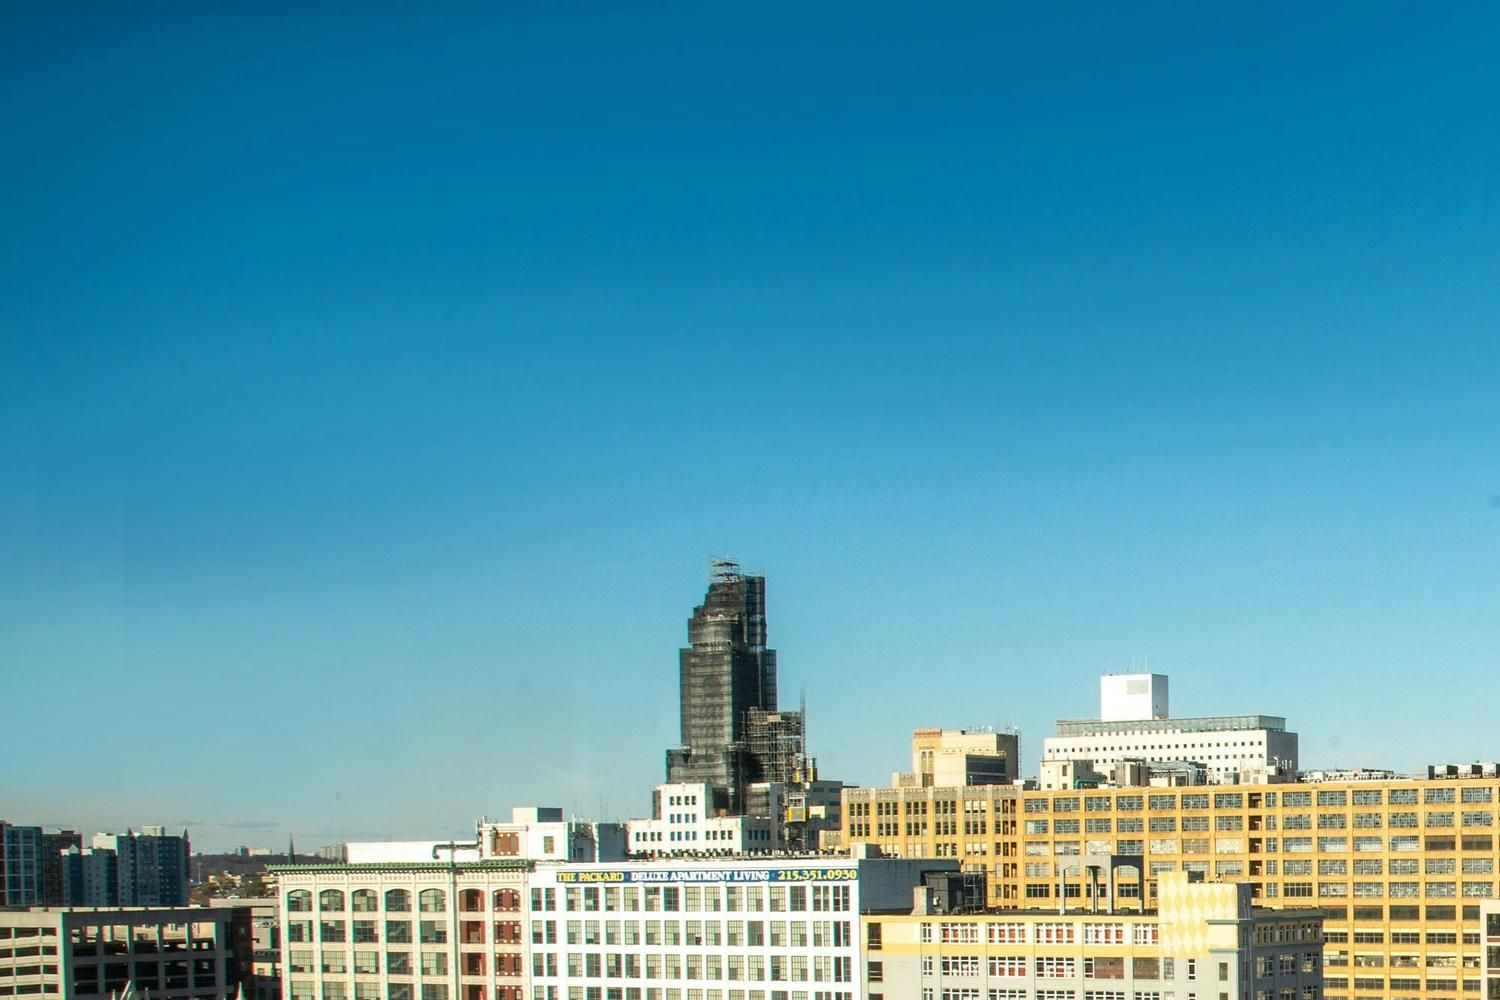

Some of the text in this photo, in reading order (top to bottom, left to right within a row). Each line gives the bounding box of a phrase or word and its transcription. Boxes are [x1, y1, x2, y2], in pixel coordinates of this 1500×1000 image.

[557, 869, 857, 881] THE PACKARD DELUXE APARTMENT LIVING 215.351.0930
